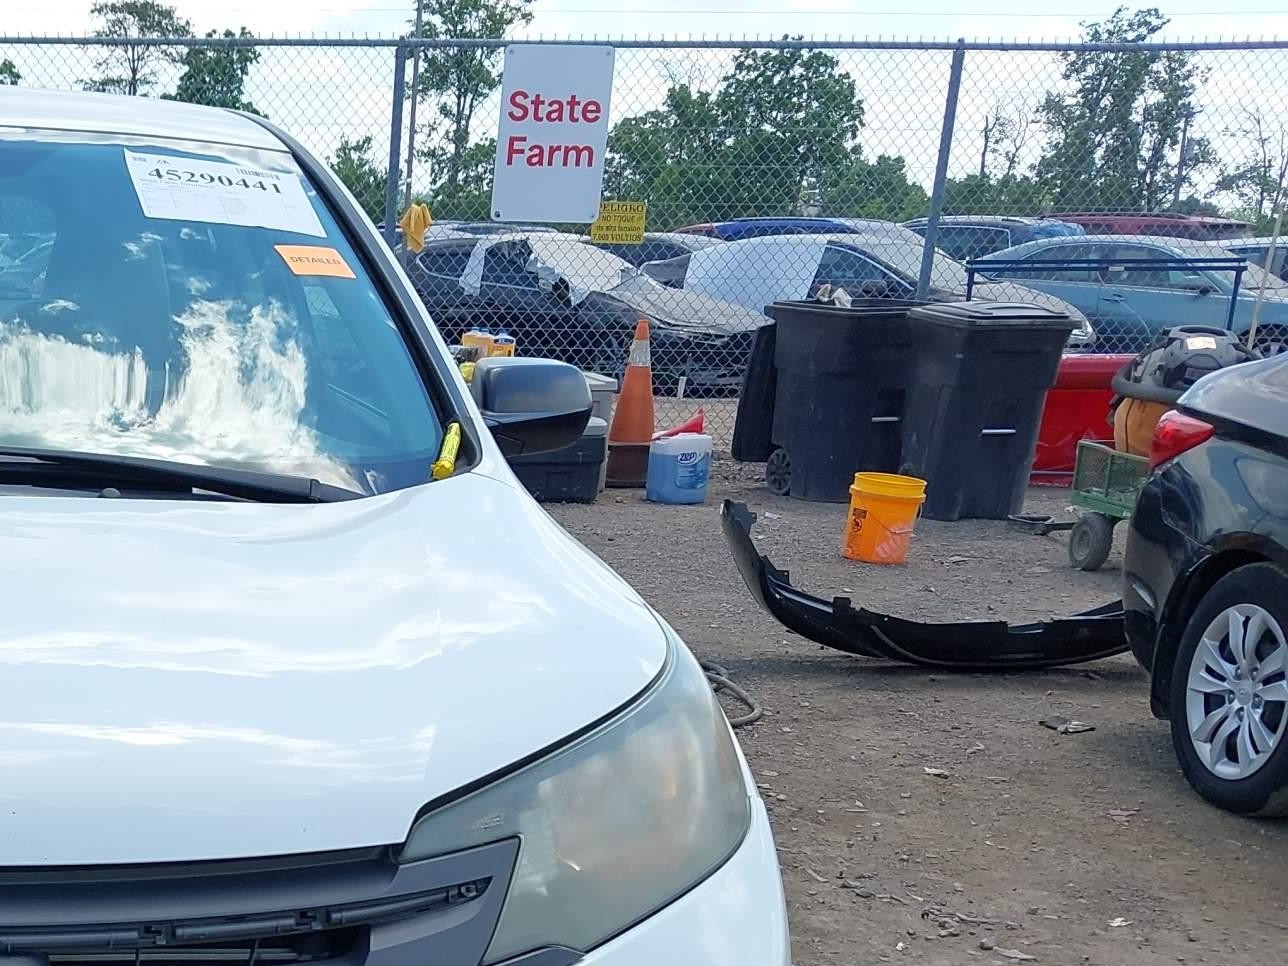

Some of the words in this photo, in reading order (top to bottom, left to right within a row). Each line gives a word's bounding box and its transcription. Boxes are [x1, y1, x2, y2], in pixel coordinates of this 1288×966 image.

[507, 90, 602, 123] State
[506, 135, 594, 168] Farm
[147, 167, 282, 195] 45290441
[289, 256, 342, 265] DETAILED
